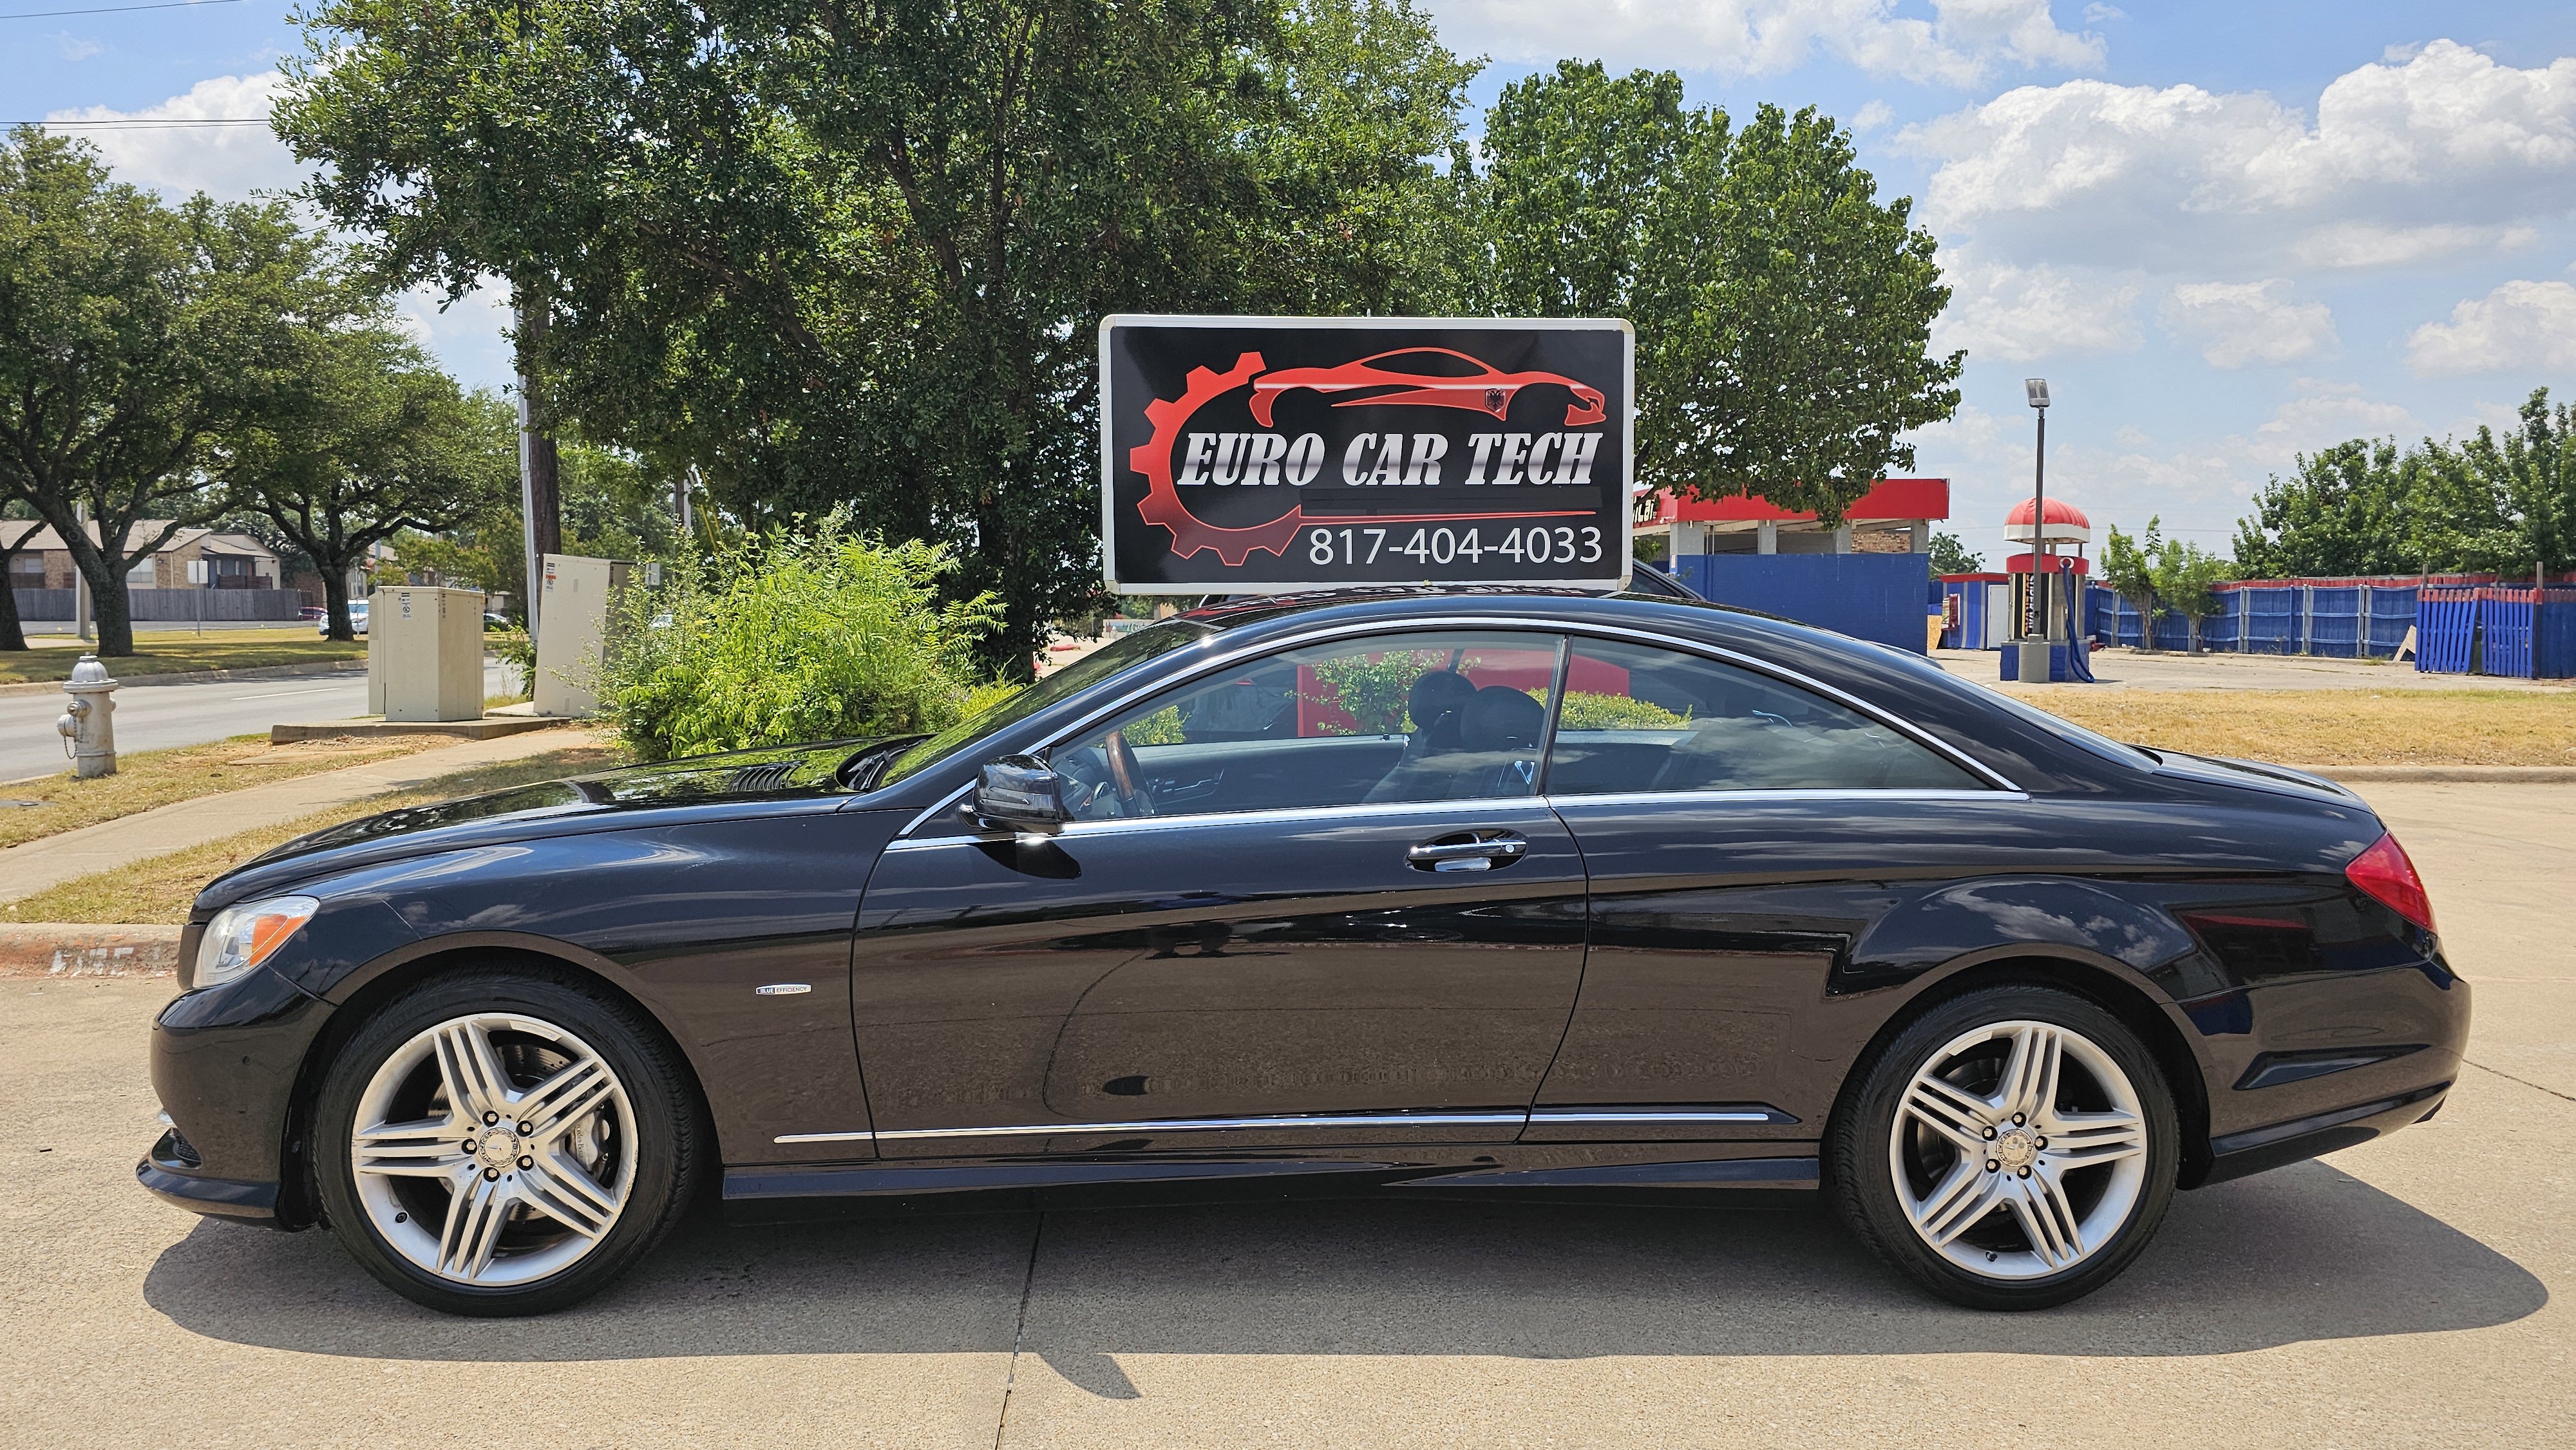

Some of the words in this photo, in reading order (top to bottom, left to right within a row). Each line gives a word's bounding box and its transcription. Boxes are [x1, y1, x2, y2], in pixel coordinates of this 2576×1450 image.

[1177, 433, 1325, 485] EURO
[1343, 433, 1448, 485] CAR
[1465, 433, 1603, 484] TECH
[1310, 527, 1602, 565] 817-404-4033
